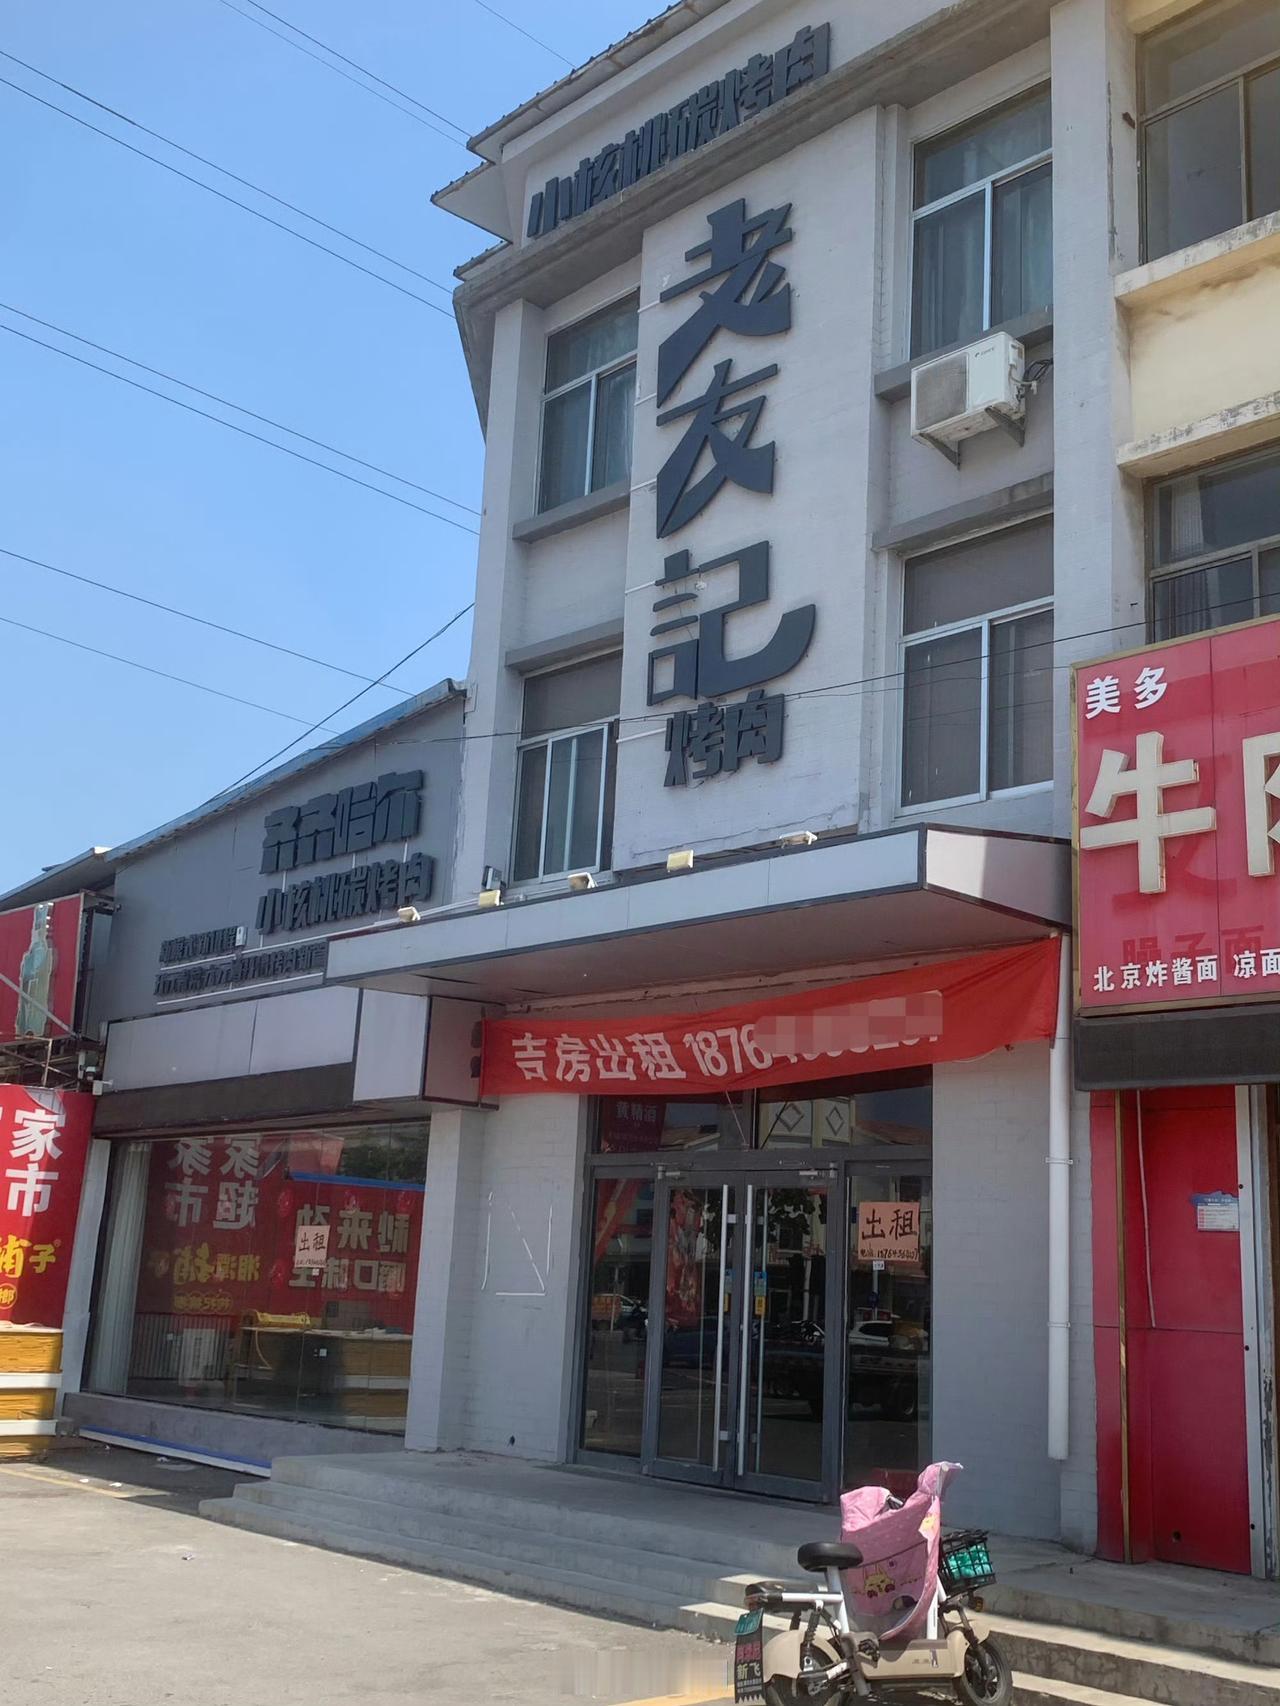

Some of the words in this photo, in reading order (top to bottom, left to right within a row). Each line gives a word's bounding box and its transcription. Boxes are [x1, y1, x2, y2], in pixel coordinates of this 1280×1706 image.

[1085, 667, 1168, 719] 美多
[663, 689, 785, 788] 烤肉
[259, 769, 424, 874] 齐齐哈尔
[1094, 954, 1218, 992] 北京炸酱面
[1233, 947, 1280, 979] 凉面
[512, 1031, 687, 1082] 吉房出租
[299, 1231, 327, 1251] 出租
[862, 1207, 917, 1240] 出租
